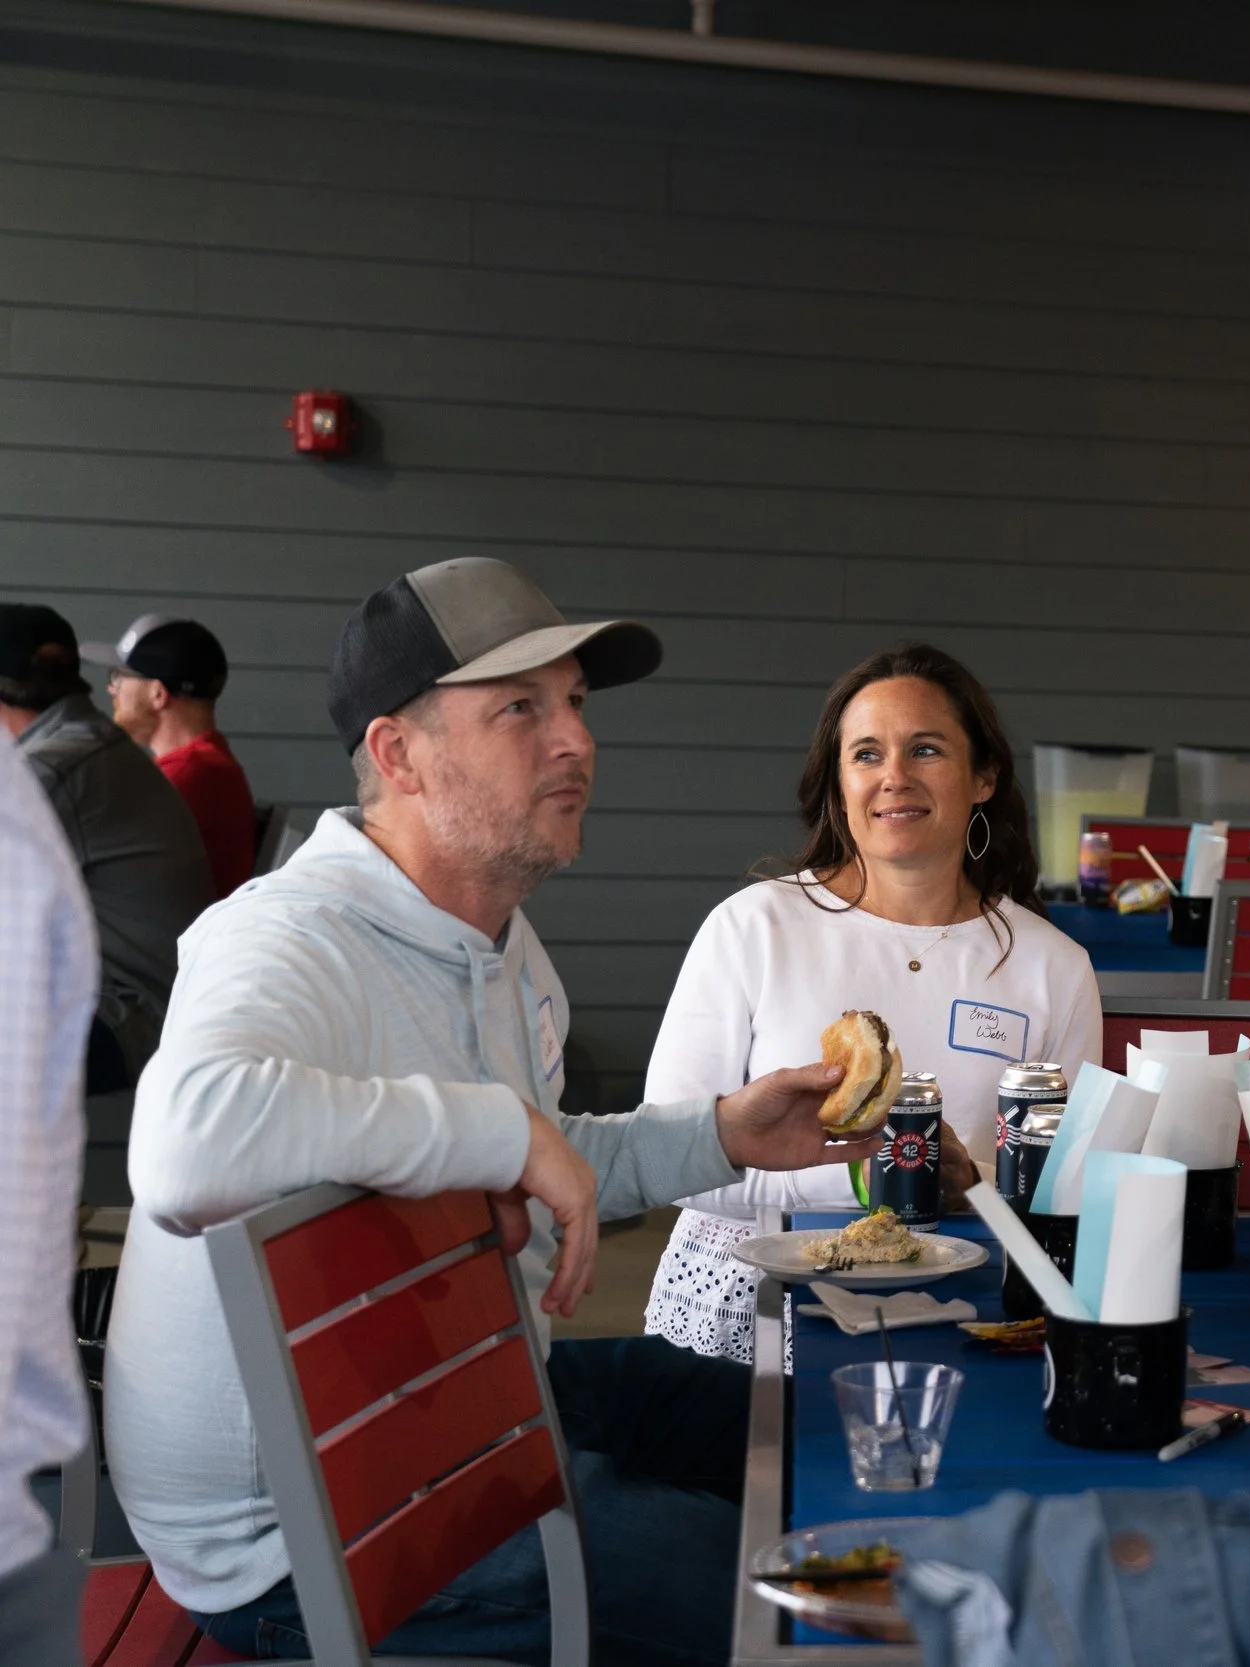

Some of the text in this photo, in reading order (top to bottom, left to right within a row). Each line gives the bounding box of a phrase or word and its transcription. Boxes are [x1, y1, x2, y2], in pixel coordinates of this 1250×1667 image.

[969, 1006, 999, 1030] Emily
[976, 1026, 1007, 1042] Webb
[902, 1144, 918, 1157] 42
